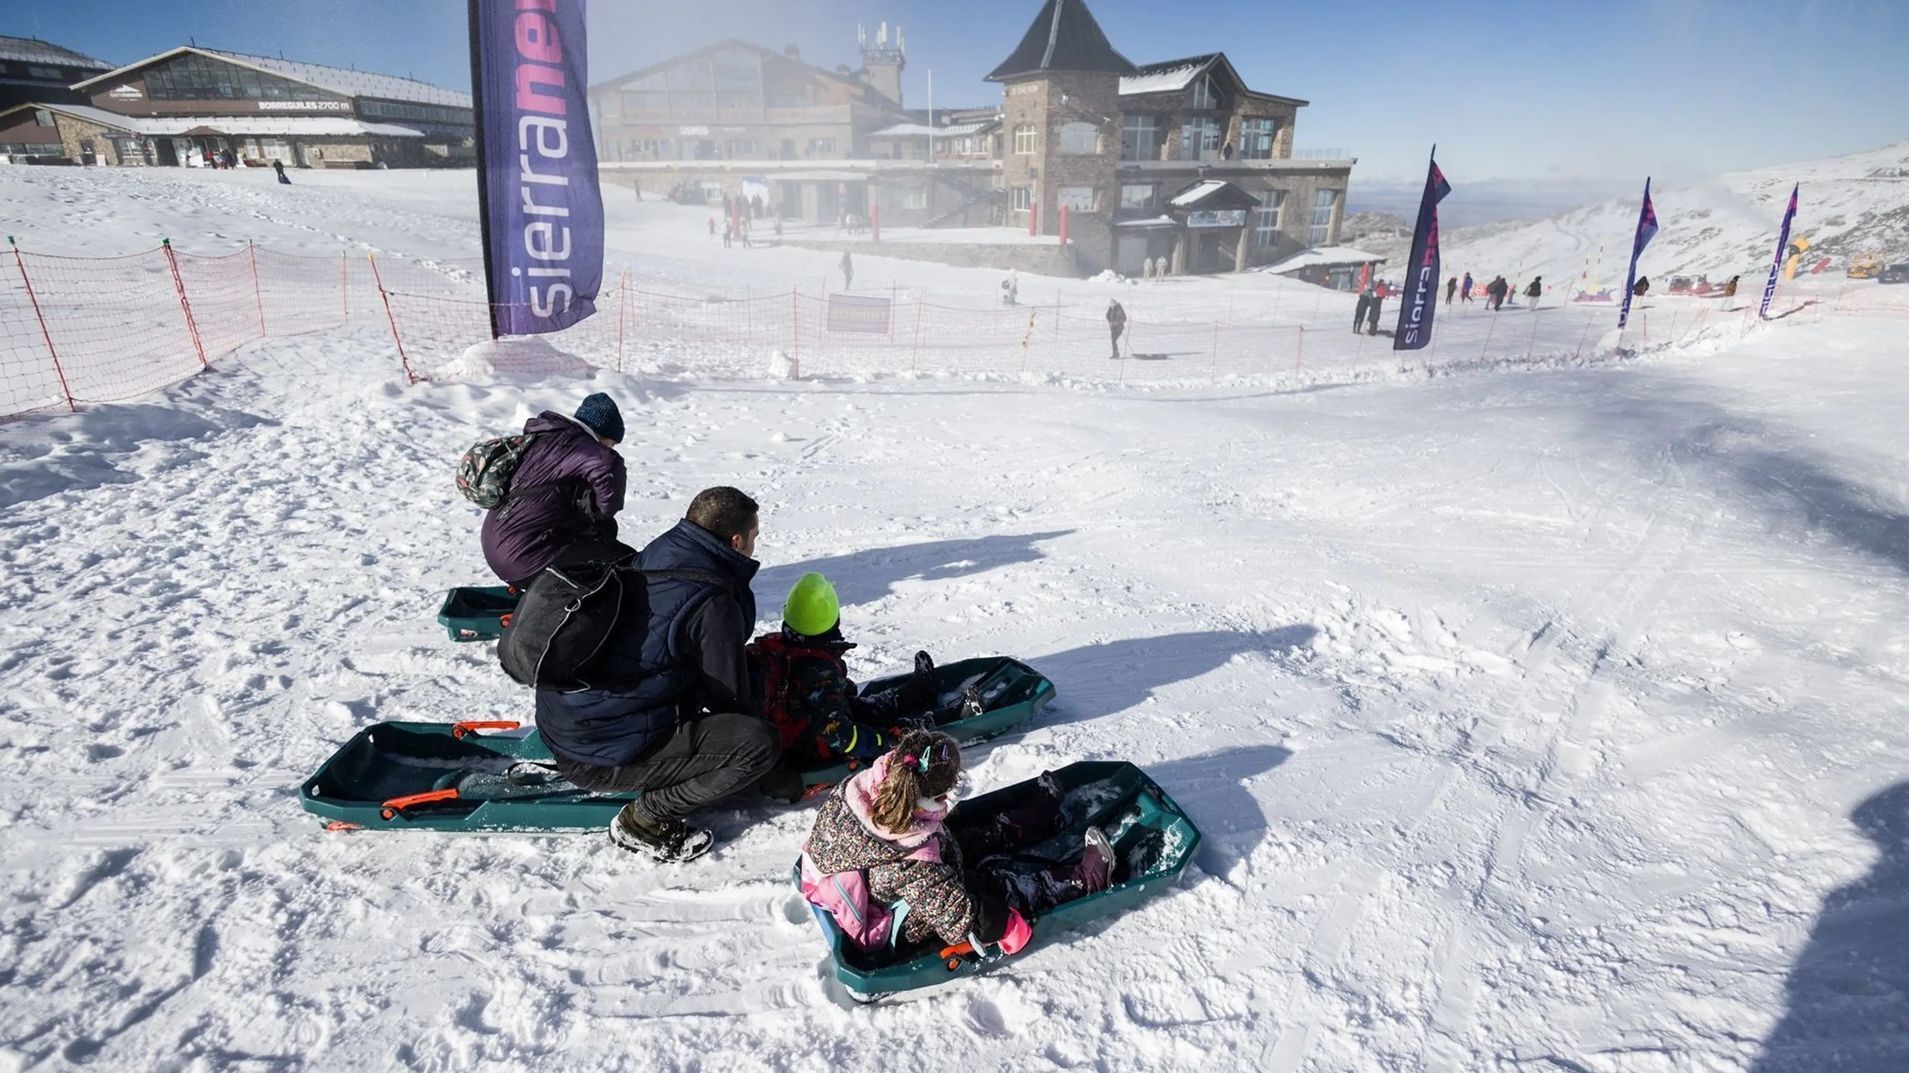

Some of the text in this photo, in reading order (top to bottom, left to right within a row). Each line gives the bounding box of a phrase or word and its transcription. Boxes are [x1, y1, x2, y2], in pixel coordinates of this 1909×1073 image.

[258, 101, 350, 110] BORREGUILES 2700 m
